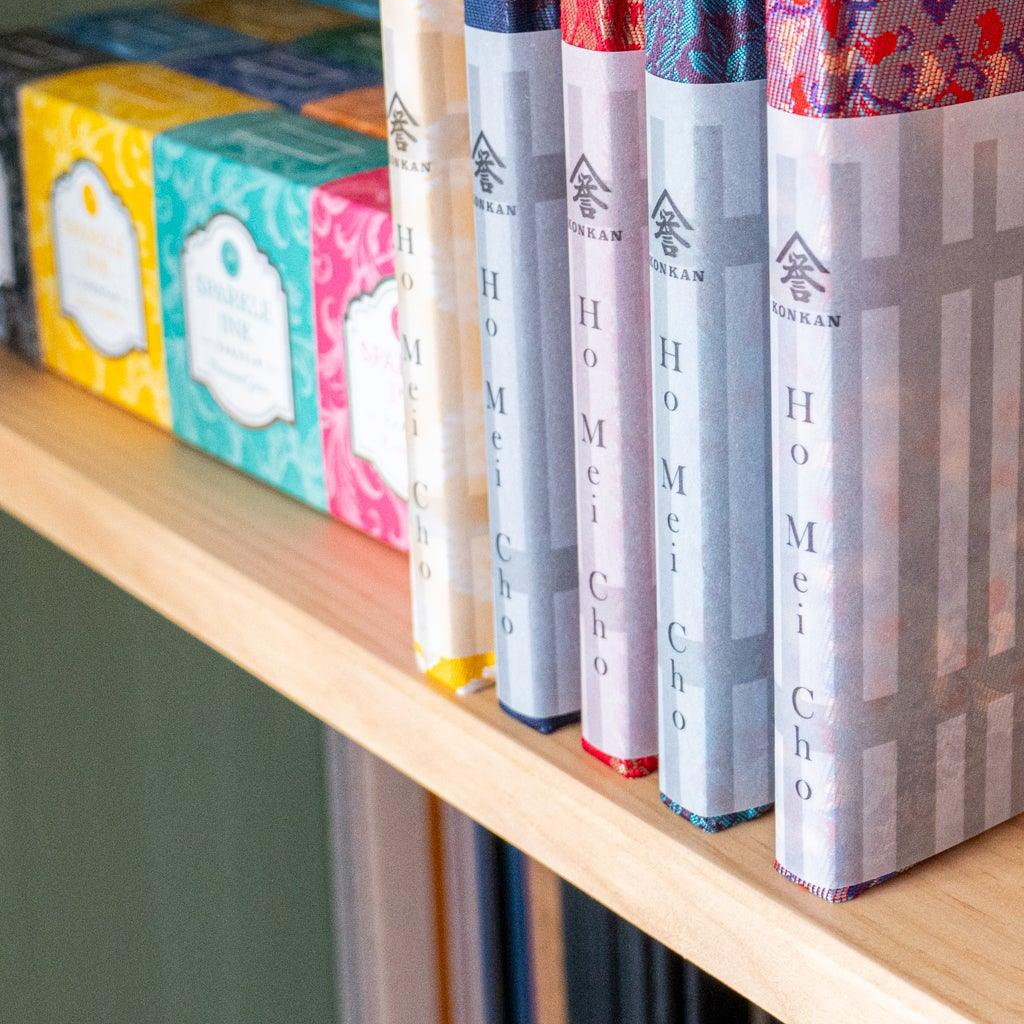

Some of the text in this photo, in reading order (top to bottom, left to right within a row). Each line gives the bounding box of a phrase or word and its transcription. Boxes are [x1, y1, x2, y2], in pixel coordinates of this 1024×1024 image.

[391, 156, 431, 173] NKAN
[474, 195, 516, 216] ONKAN
[772, 300, 841, 328] KONKAN
[397, 223, 431, 579] Ho Mei Cho
[481, 266, 513, 635] Ho Mei Cho
[578, 294, 608, 676] Ho Mei Cho
[659, 335, 687, 731] Ho Mei Cho
[785, 384, 817, 801] Ho Mei Cho
